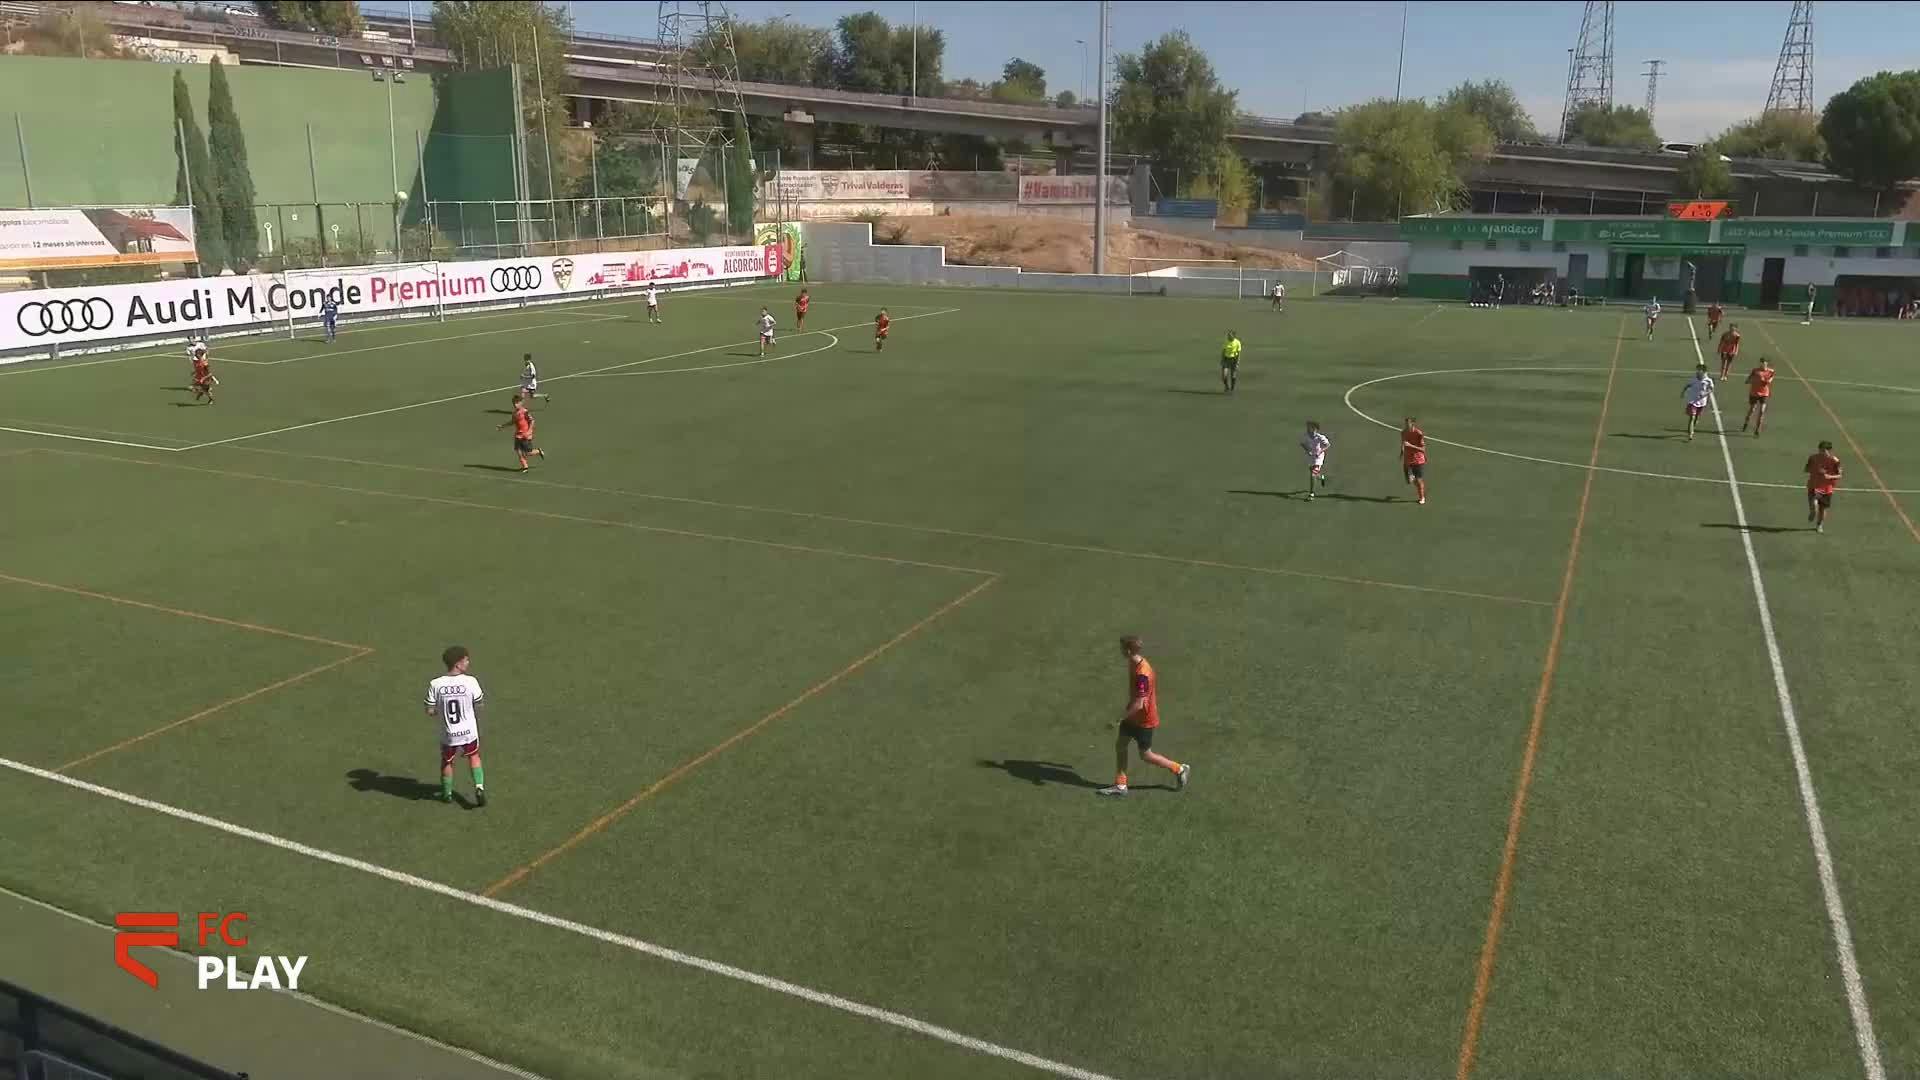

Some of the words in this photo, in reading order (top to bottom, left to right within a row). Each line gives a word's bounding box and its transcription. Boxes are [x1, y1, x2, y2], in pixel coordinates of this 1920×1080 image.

[866, 181, 904, 190] Valderas
[76, 239, 105, 247] intereses
[126, 289, 213, 327] Audi
[370, 272, 486, 303] Premium
[448, 699, 461, 725] 9
